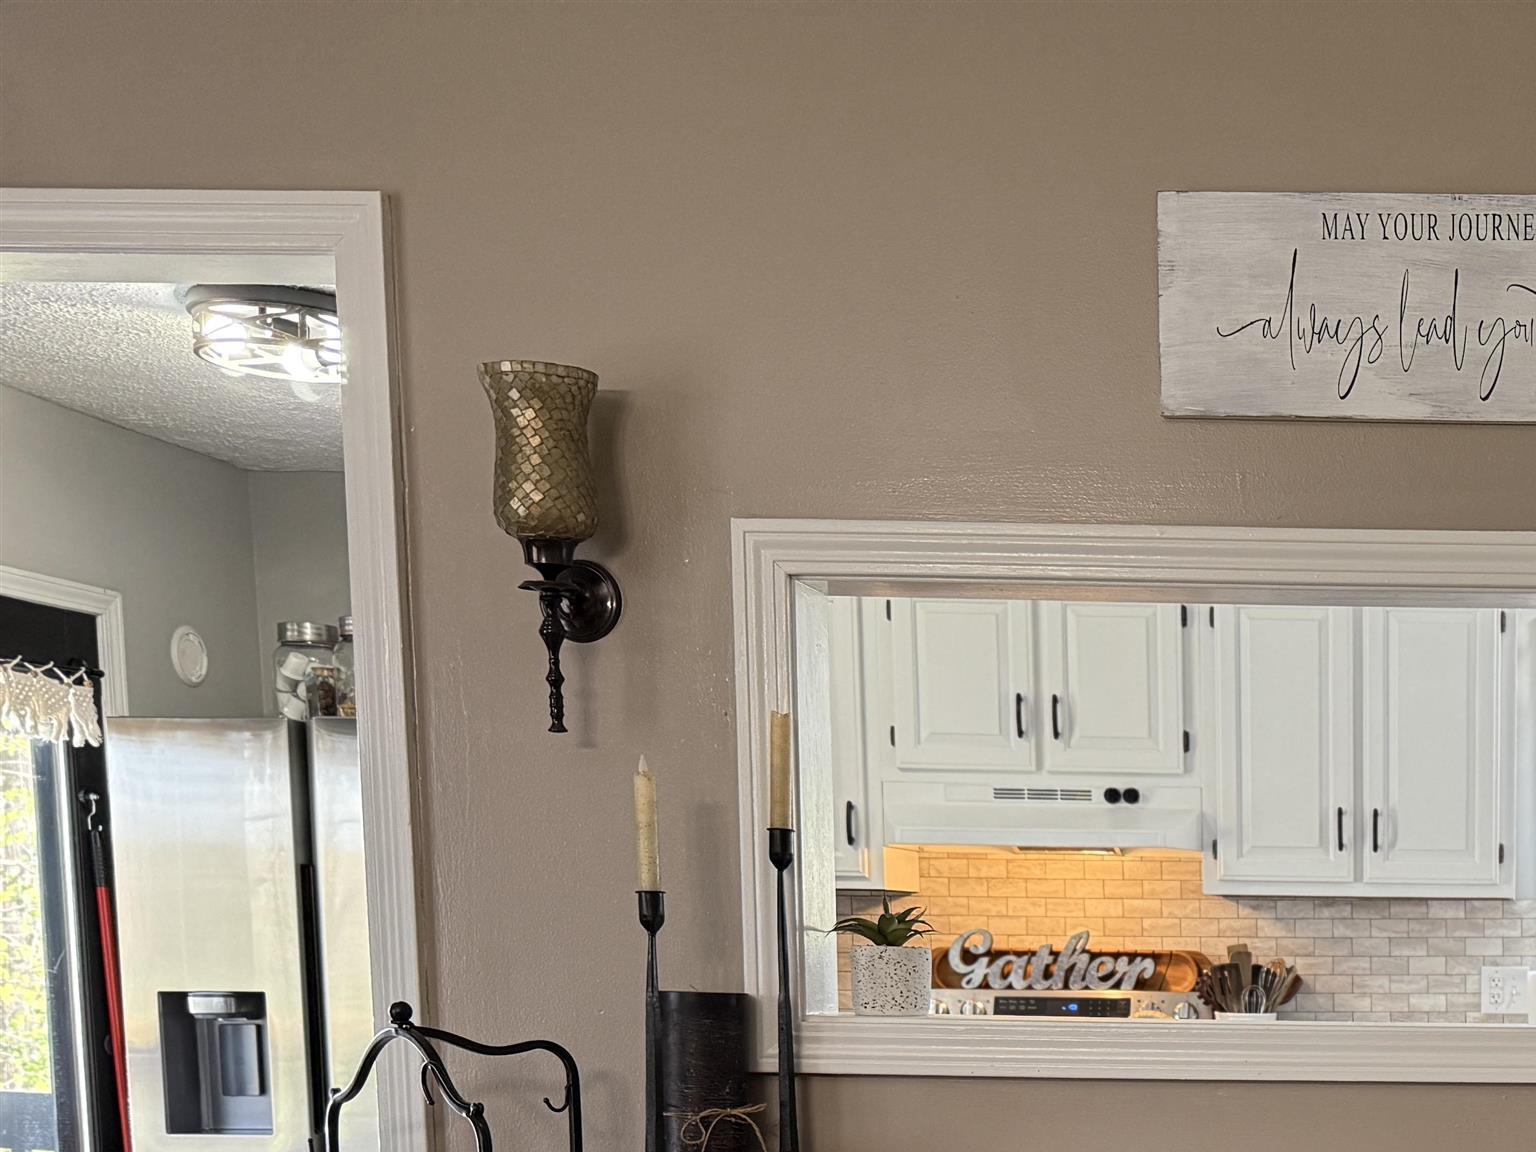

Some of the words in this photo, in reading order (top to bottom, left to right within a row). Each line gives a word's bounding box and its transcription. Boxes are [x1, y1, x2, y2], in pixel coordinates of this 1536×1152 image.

[1321, 211, 1368, 241] MAY
[1378, 212, 1440, 242] YOUR
[1217, 247, 1389, 401] always
[1399, 268, 1468, 372] lead
[1477, 310, 1536, 402] you
[947, 928, 1155, 990] Gather
